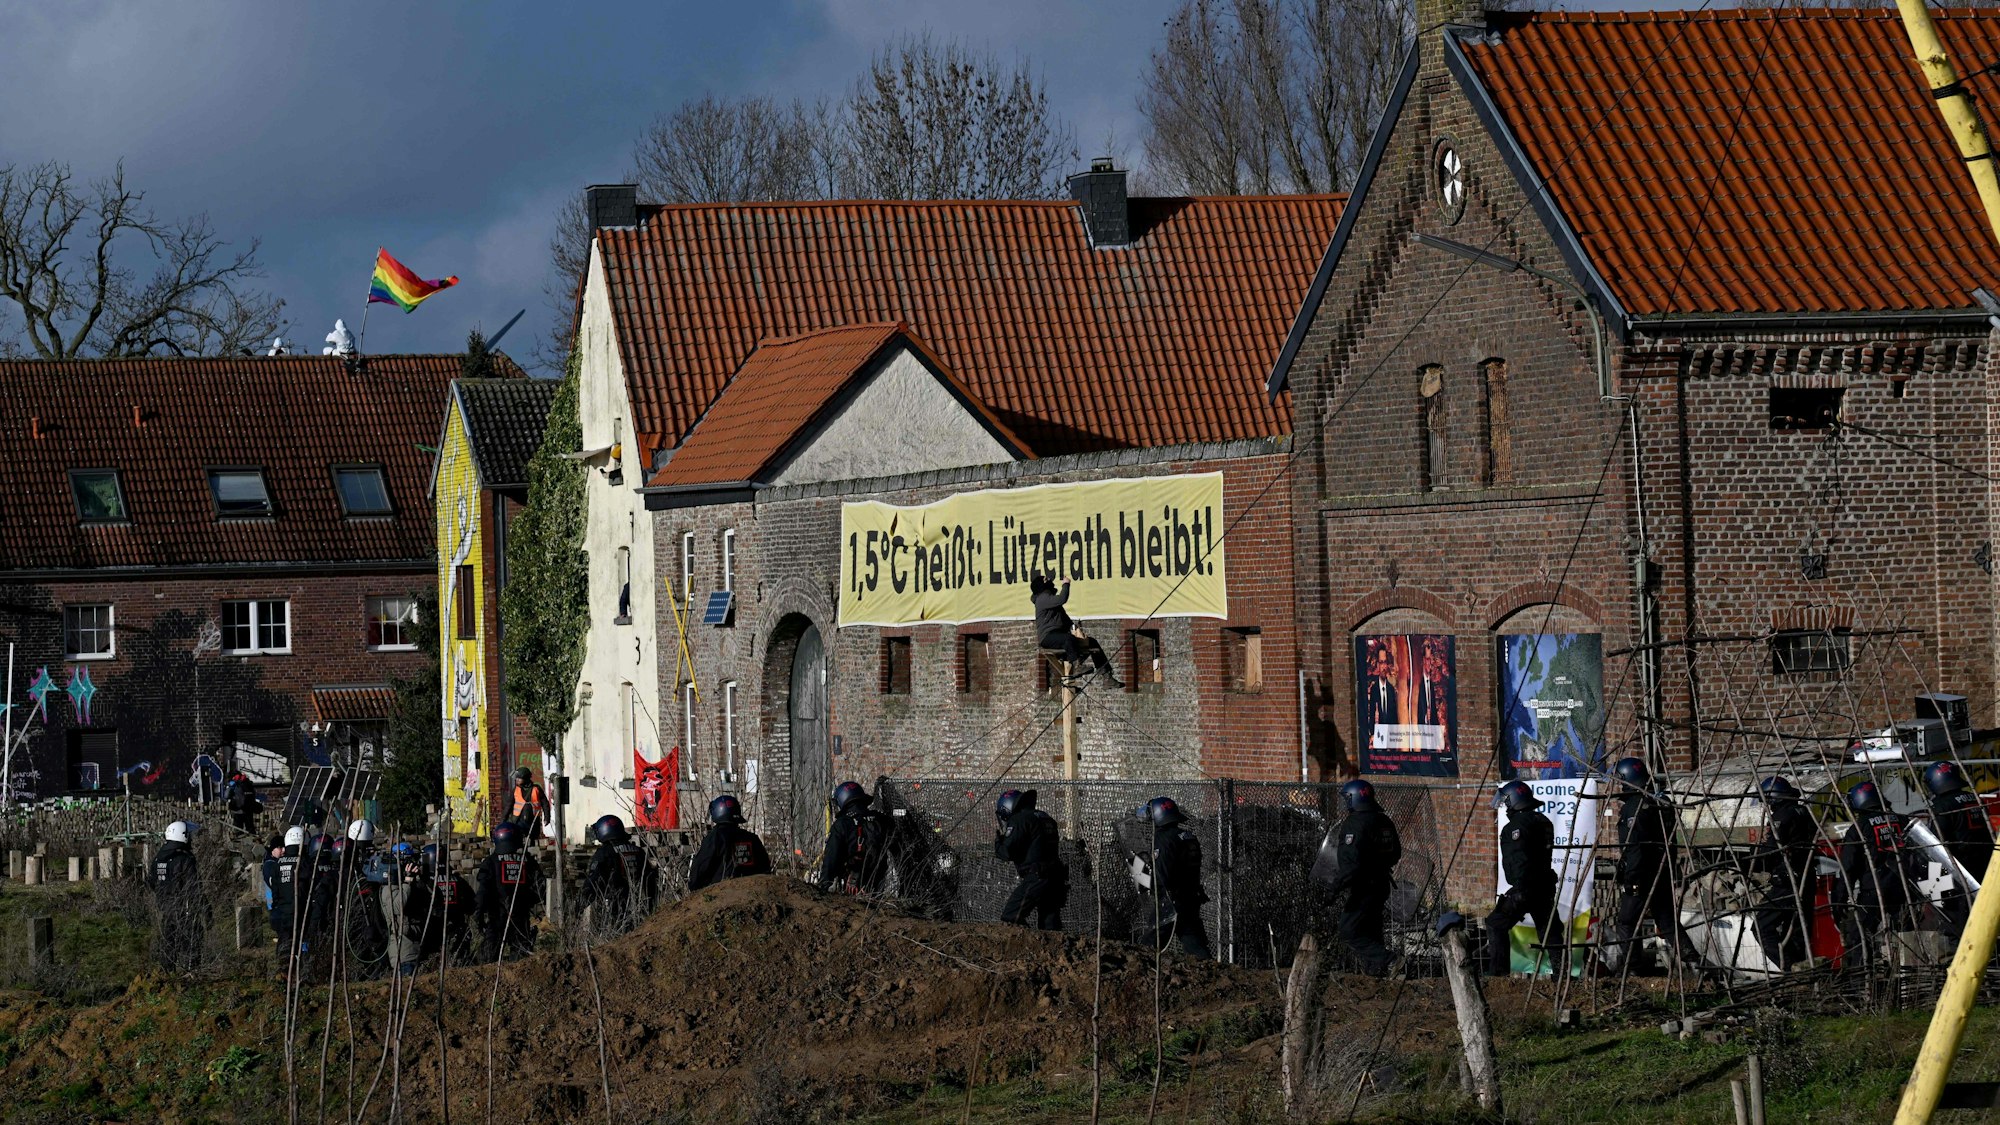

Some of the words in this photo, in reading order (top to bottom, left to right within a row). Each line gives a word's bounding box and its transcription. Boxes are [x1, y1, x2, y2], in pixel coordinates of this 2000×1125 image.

[849, 530, 908, 601] 1,5°C
[988, 515, 1112, 585] Lützerath
[1119, 505, 1213, 579] bleibt!
[1531, 784, 1576, 796] lcome
[1537, 800, 1577, 815] OP23
[1555, 836, 1580, 845] OP3
